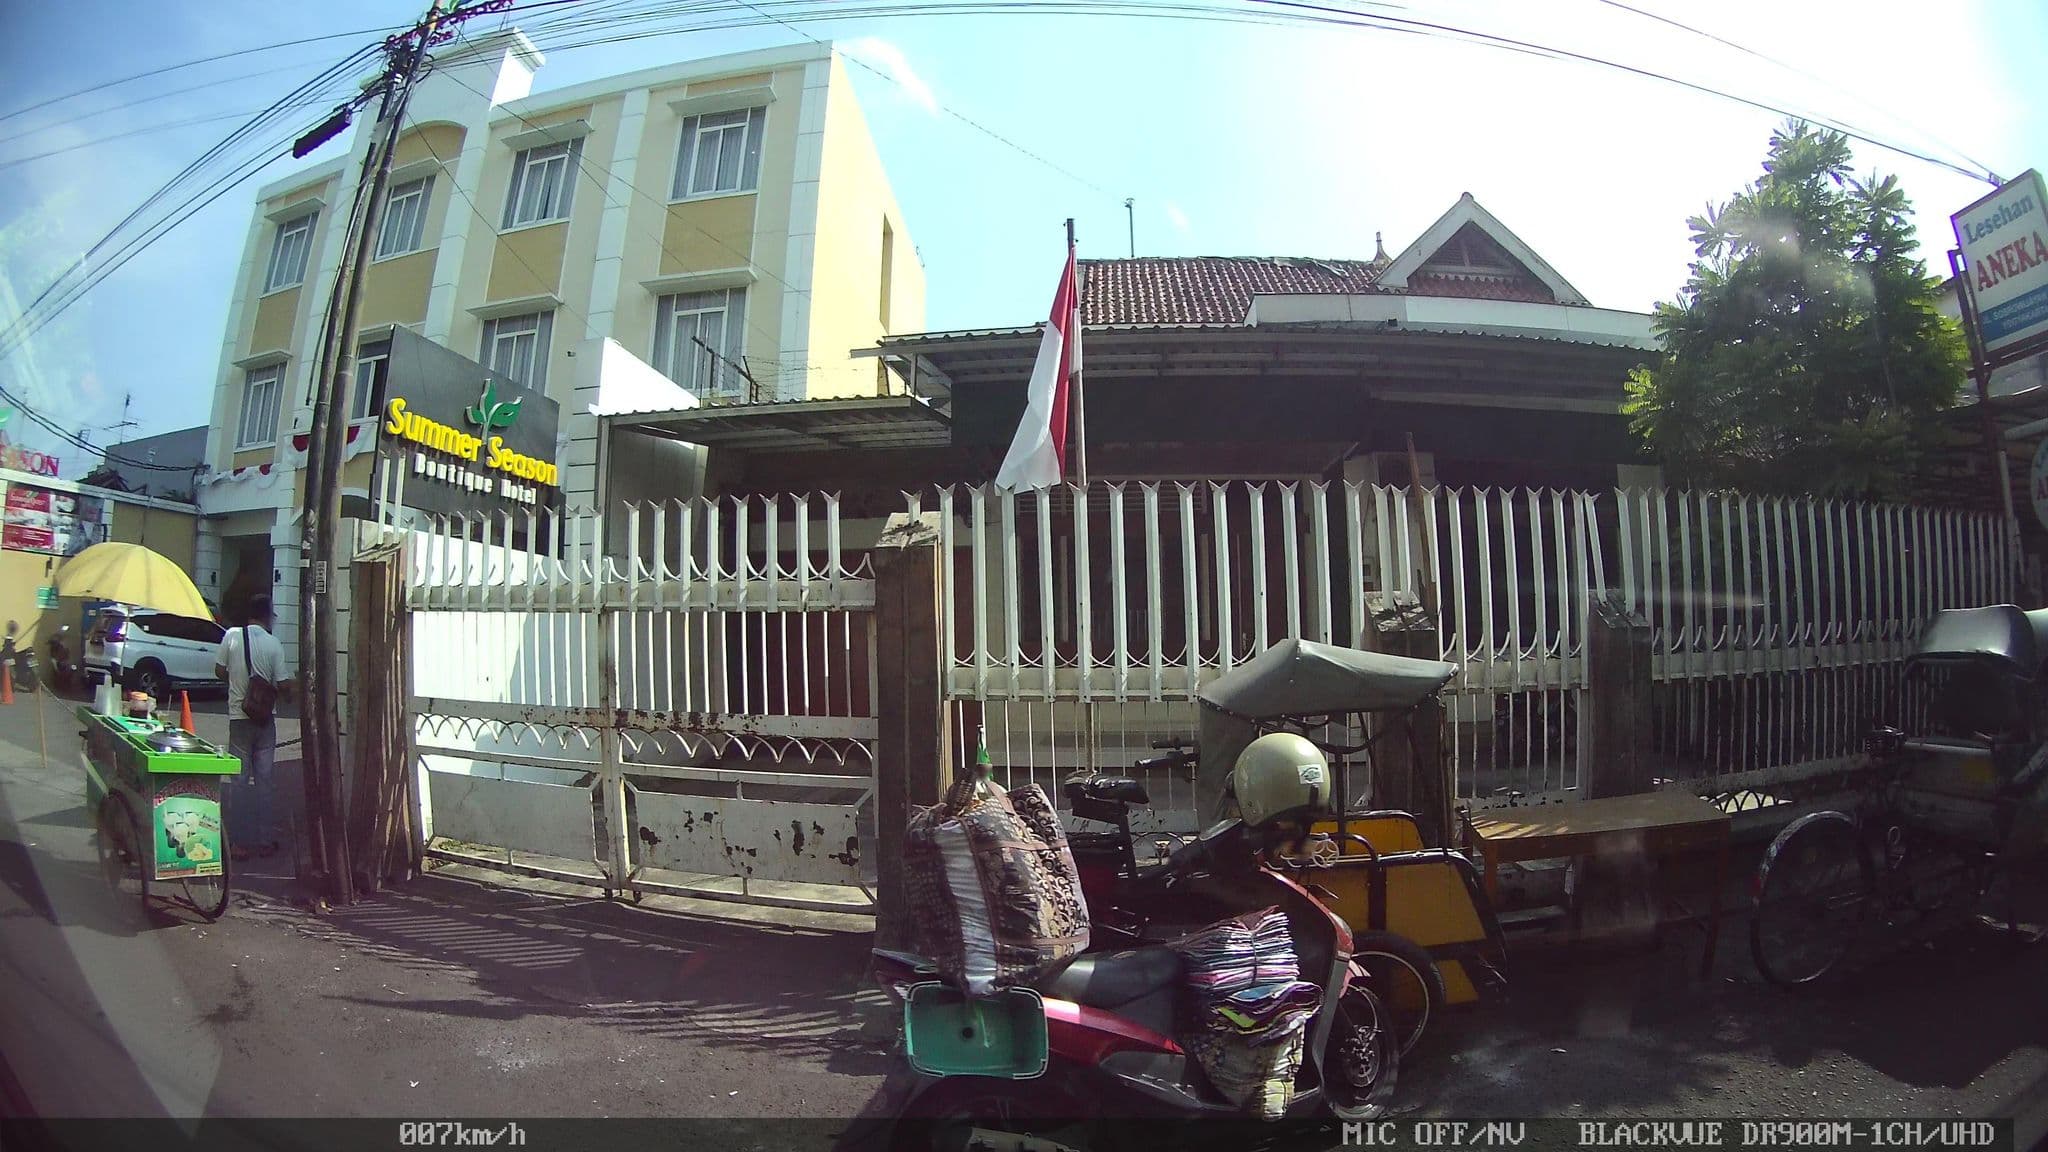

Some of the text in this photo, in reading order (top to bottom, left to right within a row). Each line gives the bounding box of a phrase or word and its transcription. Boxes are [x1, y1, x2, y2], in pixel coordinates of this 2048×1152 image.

[1963, 194, 2034, 245] Lesehan
[1976, 230, 2048, 291] ANEKA
[386, 397, 558, 486] Summer Season
[415, 452, 537, 505] Boutique Hotel
